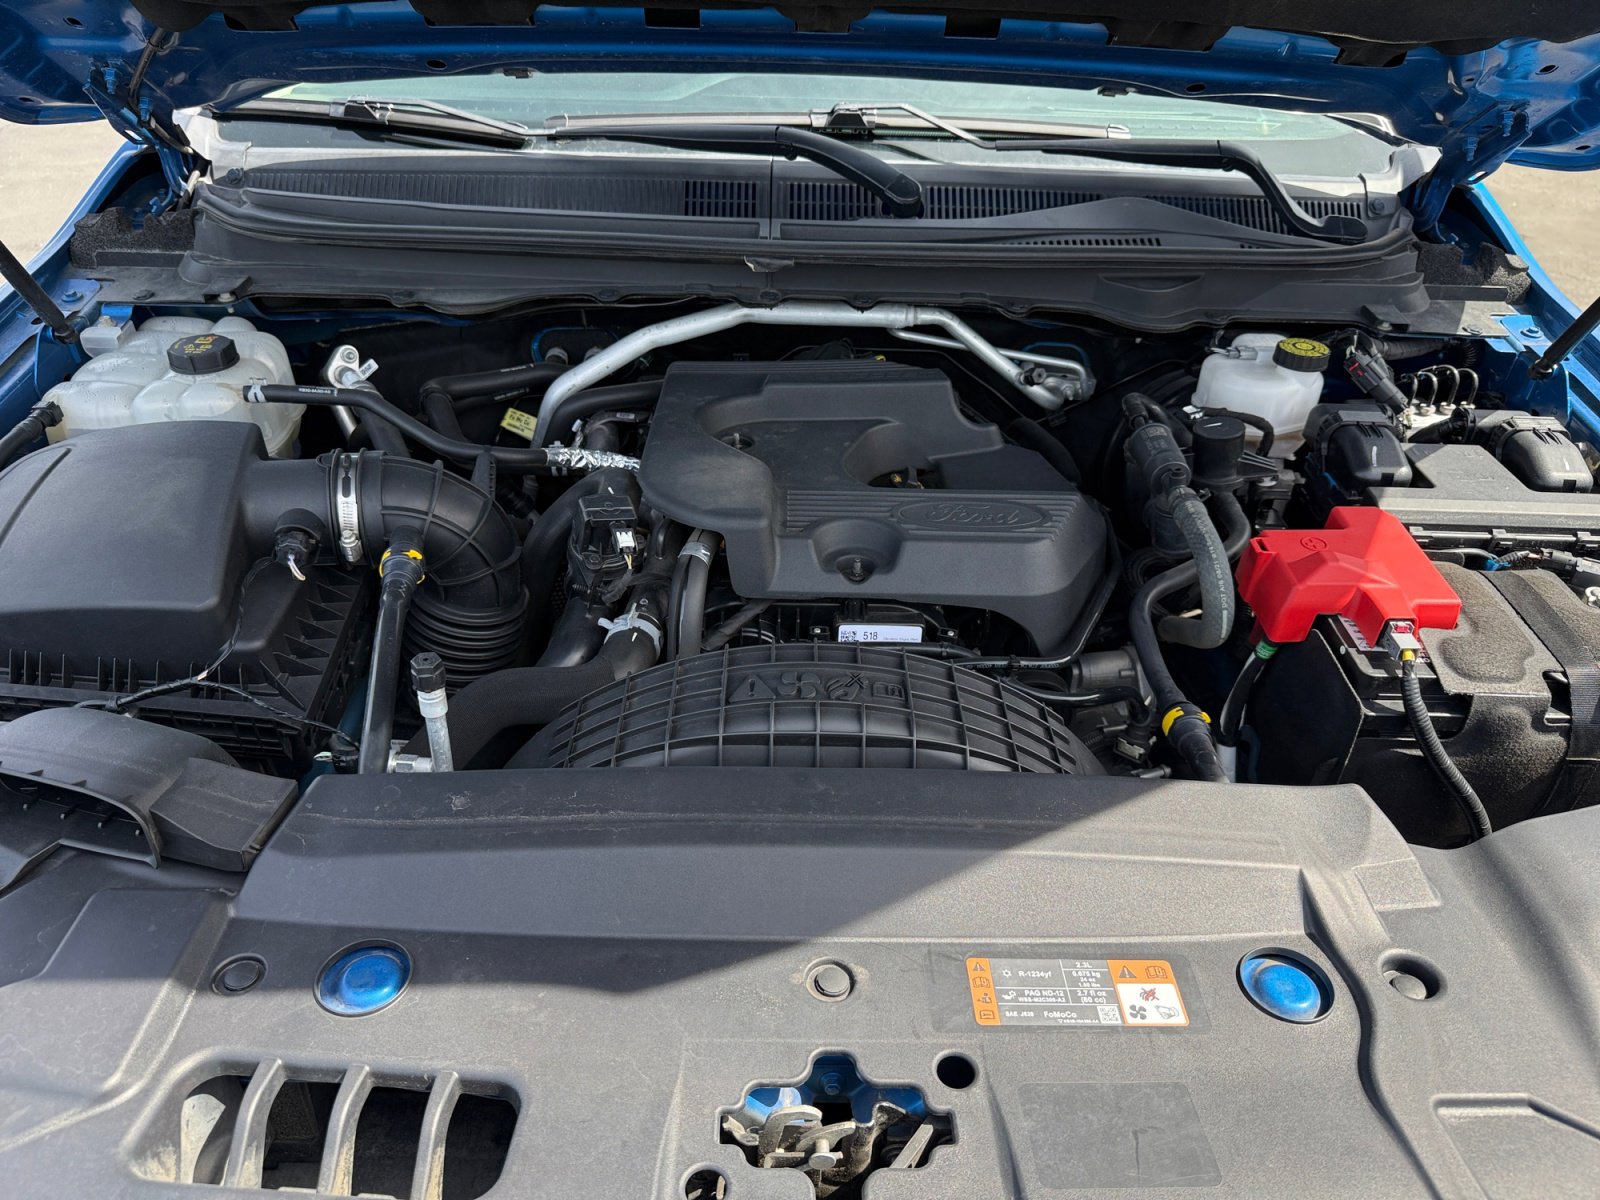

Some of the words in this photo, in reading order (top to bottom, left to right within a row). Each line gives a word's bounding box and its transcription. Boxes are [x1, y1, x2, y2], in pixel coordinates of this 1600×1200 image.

[929, 503, 1019, 524] Ford
[863, 631, 878, 640] 518
[1018, 970, 1052, 978] R-1234yf
[1094, 996, 1107, 1004] cc)
[1043, 1010, 1078, 1018] FoMoCo
